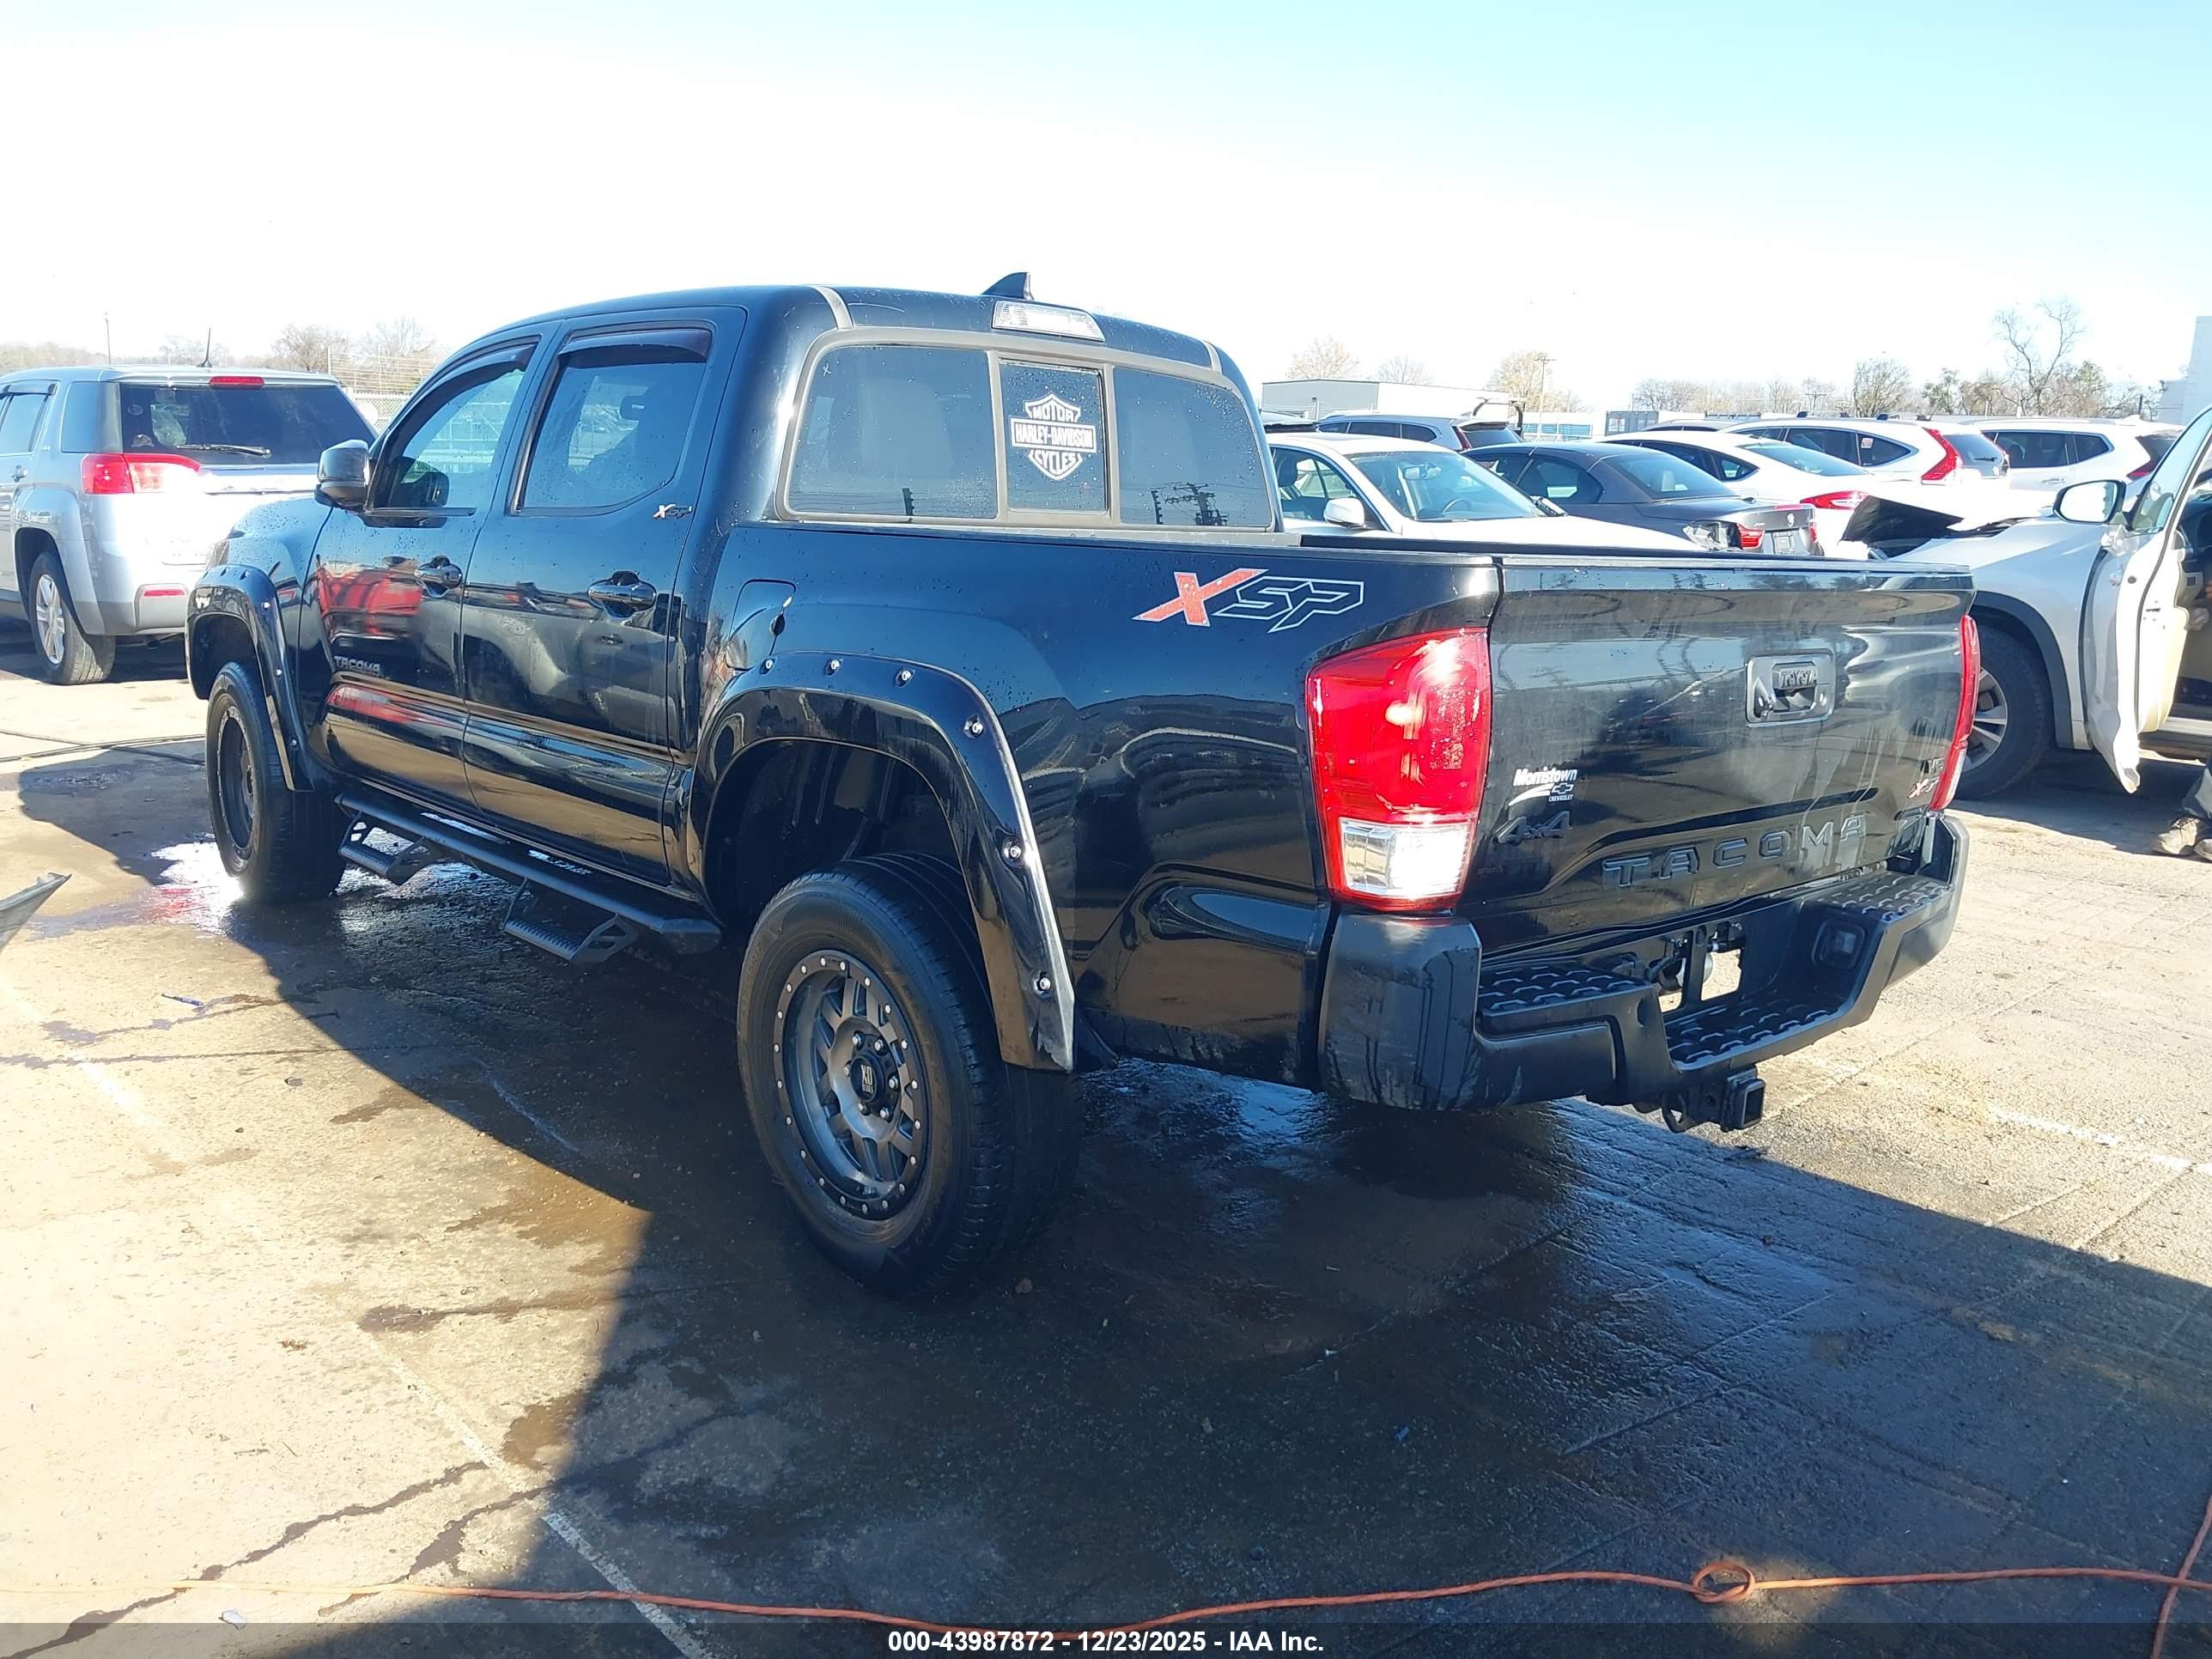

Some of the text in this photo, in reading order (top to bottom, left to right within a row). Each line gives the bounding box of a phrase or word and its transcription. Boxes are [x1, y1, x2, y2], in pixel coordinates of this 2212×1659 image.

[1031, 398, 1075, 422] MOTOR
[1014, 422, 1093, 448] HARLEY-DAVIDSON
[1034, 449, 1077, 476] CYCLES
[333, 655, 384, 677] TACOMA
[1780, 669, 1818, 689] TOYOTA
[1512, 766, 1578, 787] Morristown
[1548, 794, 1573, 803] CHEVROLET
[1602, 812, 1868, 888] TACOMA
